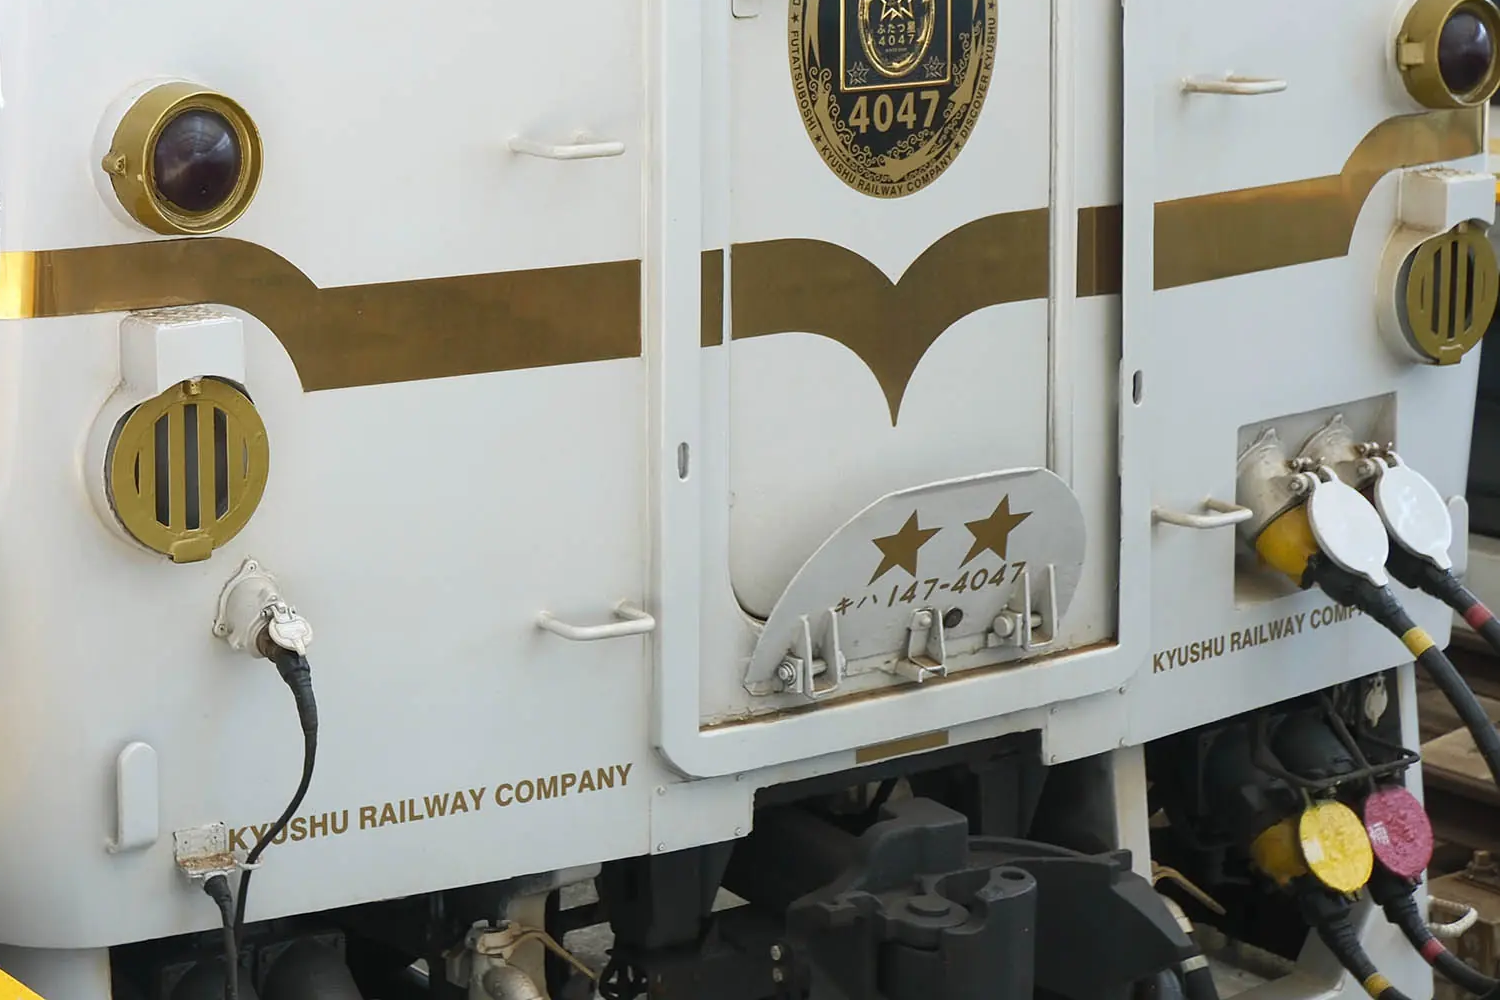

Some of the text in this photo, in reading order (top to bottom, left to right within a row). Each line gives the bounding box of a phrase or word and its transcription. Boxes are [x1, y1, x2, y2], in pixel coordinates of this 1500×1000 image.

[878, 34, 915, 47] 4047
[791, 30, 818, 132] FUTATSUBOSHI
[961, 16, 997, 140] DISCOVER KYUSHU
[848, 90, 941, 134] 4047
[820, 144, 954, 197] KYUSHU RAILWAY COMPANY
[1152, 635, 1224, 674] KYUSHU
[1229, 613, 1306, 652] RAILWAY
[359, 787, 486, 830] RAILWAY
[495, 763, 633, 807] COMPANY
